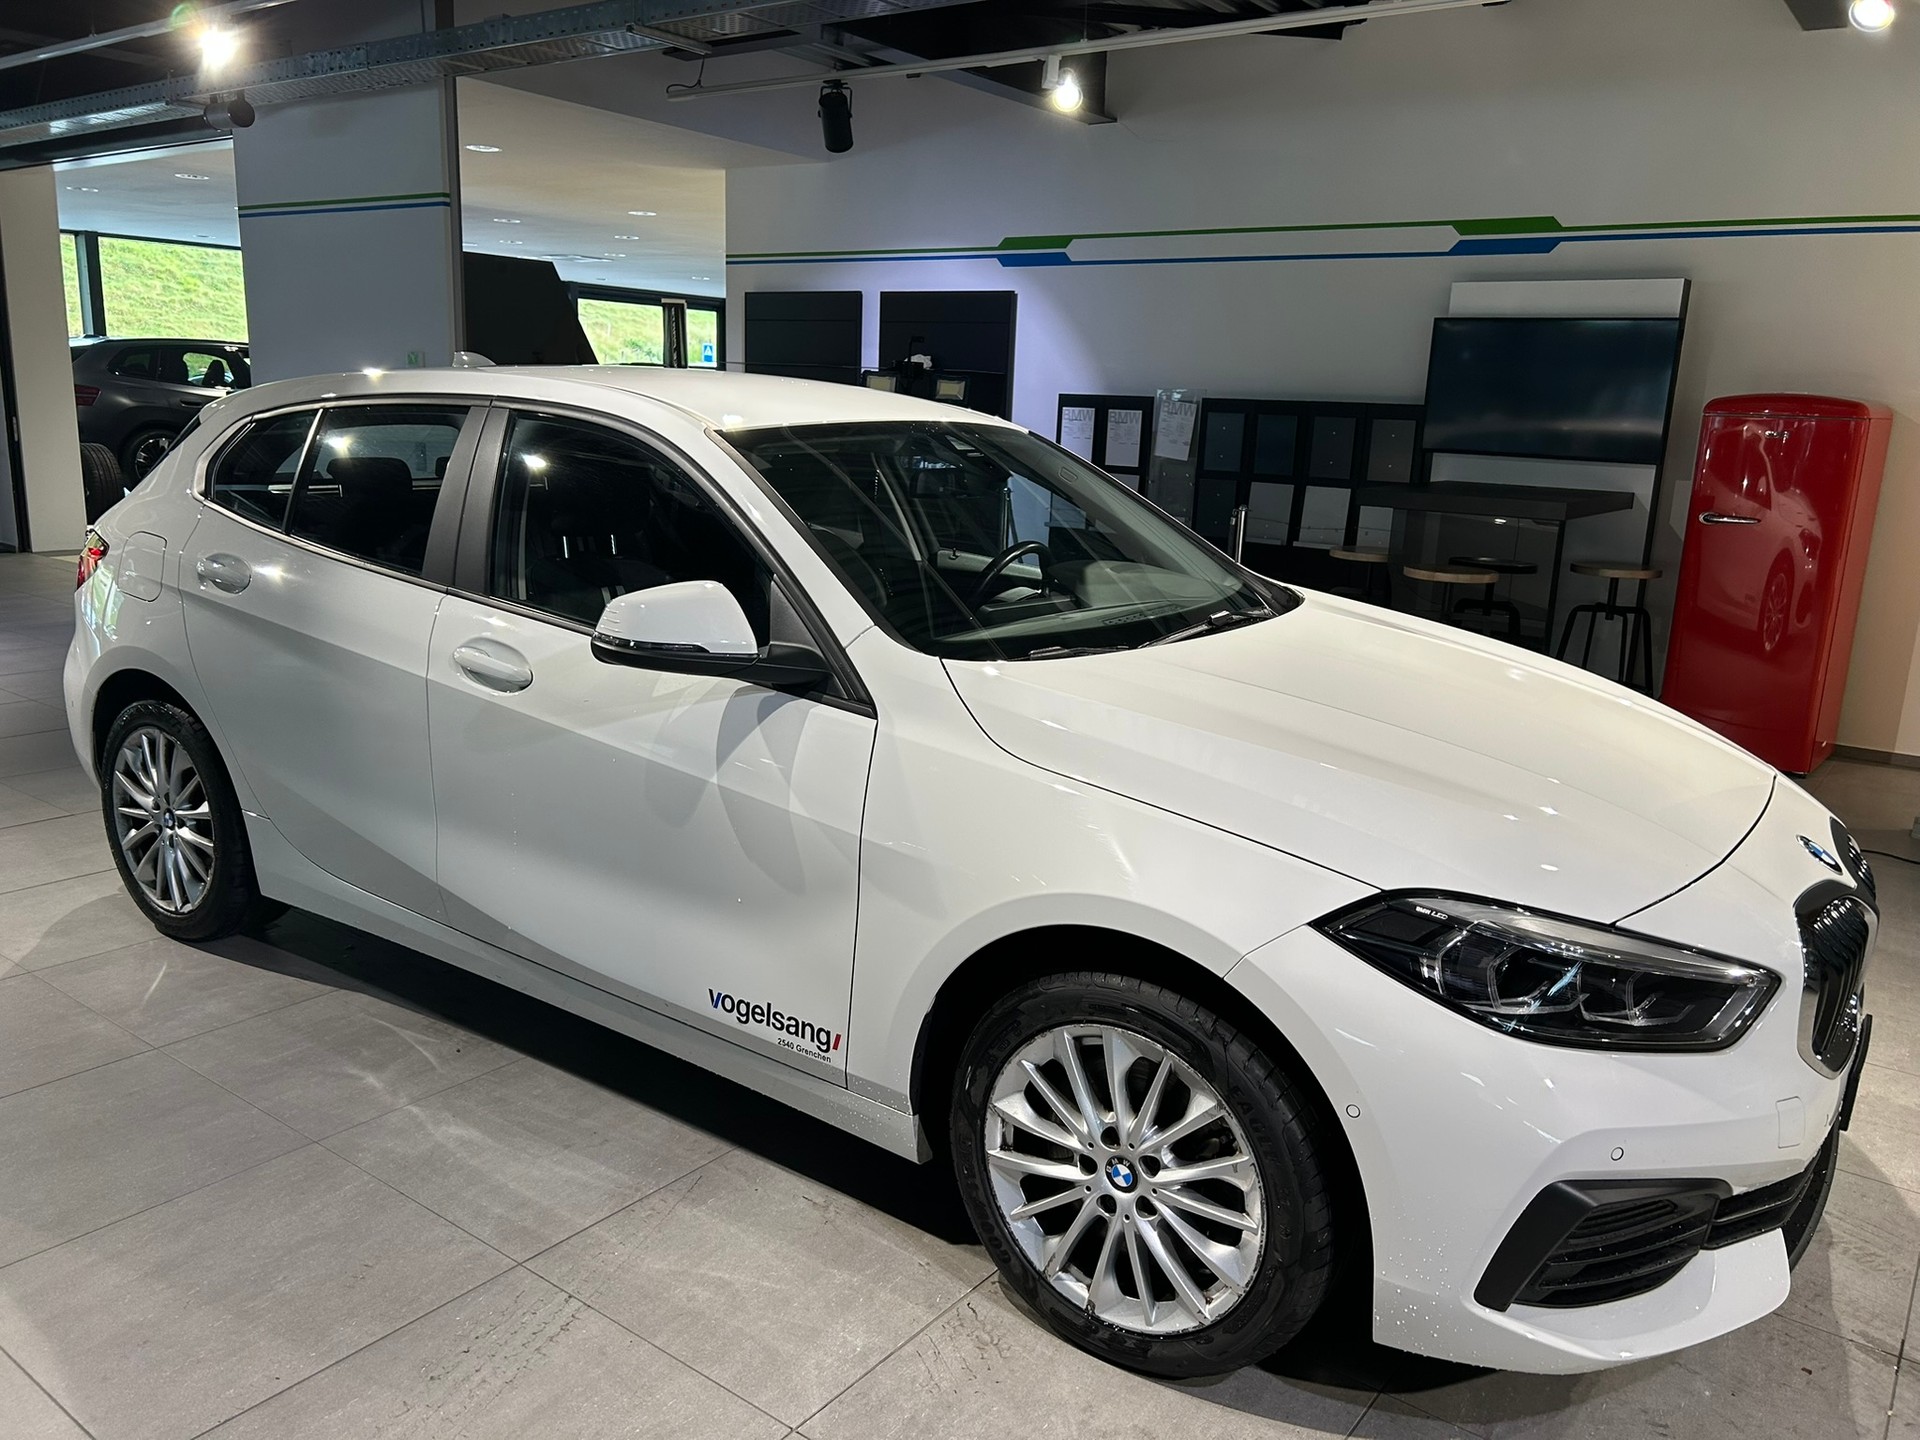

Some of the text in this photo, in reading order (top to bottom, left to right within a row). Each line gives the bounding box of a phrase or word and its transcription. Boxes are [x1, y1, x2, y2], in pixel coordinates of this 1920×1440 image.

[1063, 408, 1093, 421] BMW
[1162, 401, 1195, 417] BMW
[1108, 411, 1139, 424] BMW
[777, 1037, 832, 1063] 2540 Grenchen
[1106, 1158, 1131, 1173] BMW
